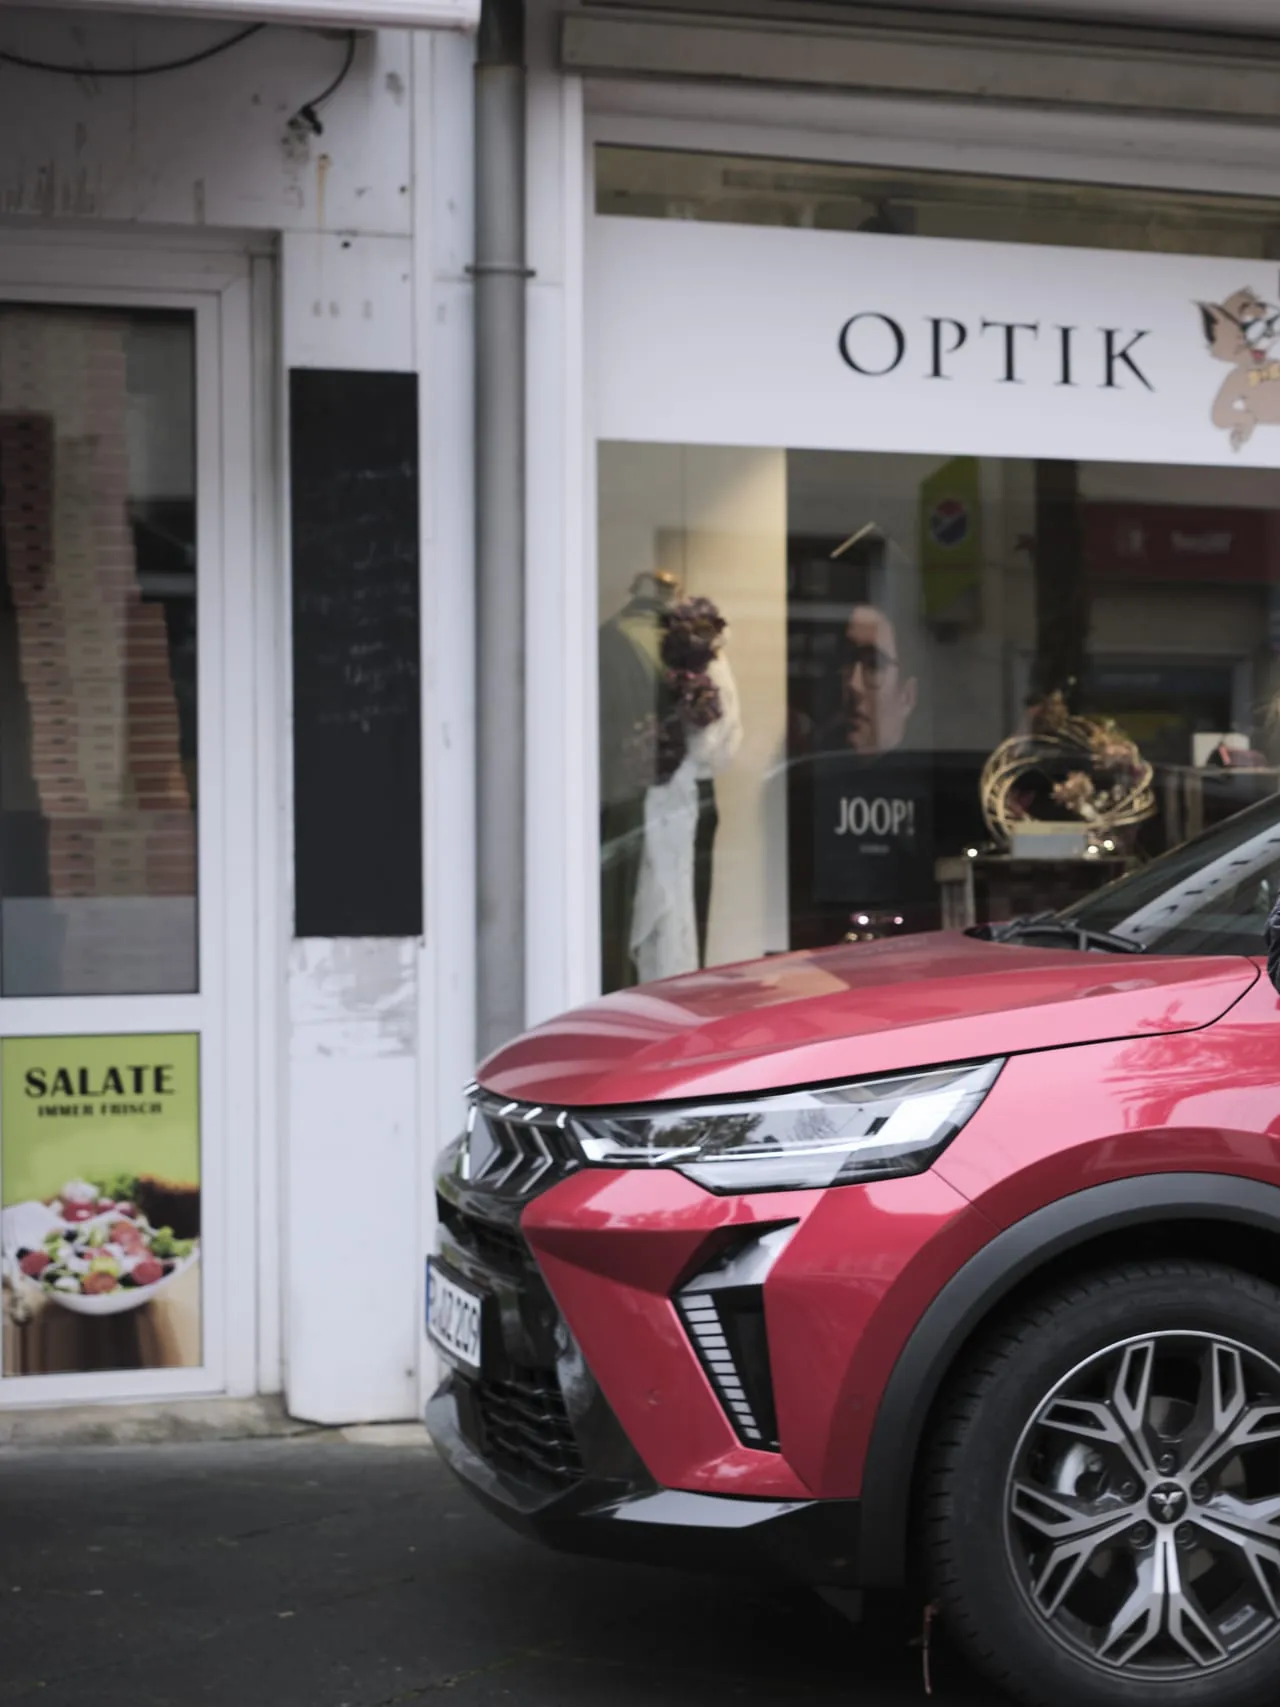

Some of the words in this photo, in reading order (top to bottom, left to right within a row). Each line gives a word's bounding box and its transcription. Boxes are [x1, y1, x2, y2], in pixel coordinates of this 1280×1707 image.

[837, 312, 1154, 391] OPTIK
[834, 796, 915, 836] JOOP!
[24, 1064, 175, 1099] SALATE
[38, 1103, 94, 1118] IMMER
[101, 1102, 162, 1116] FRISCH
